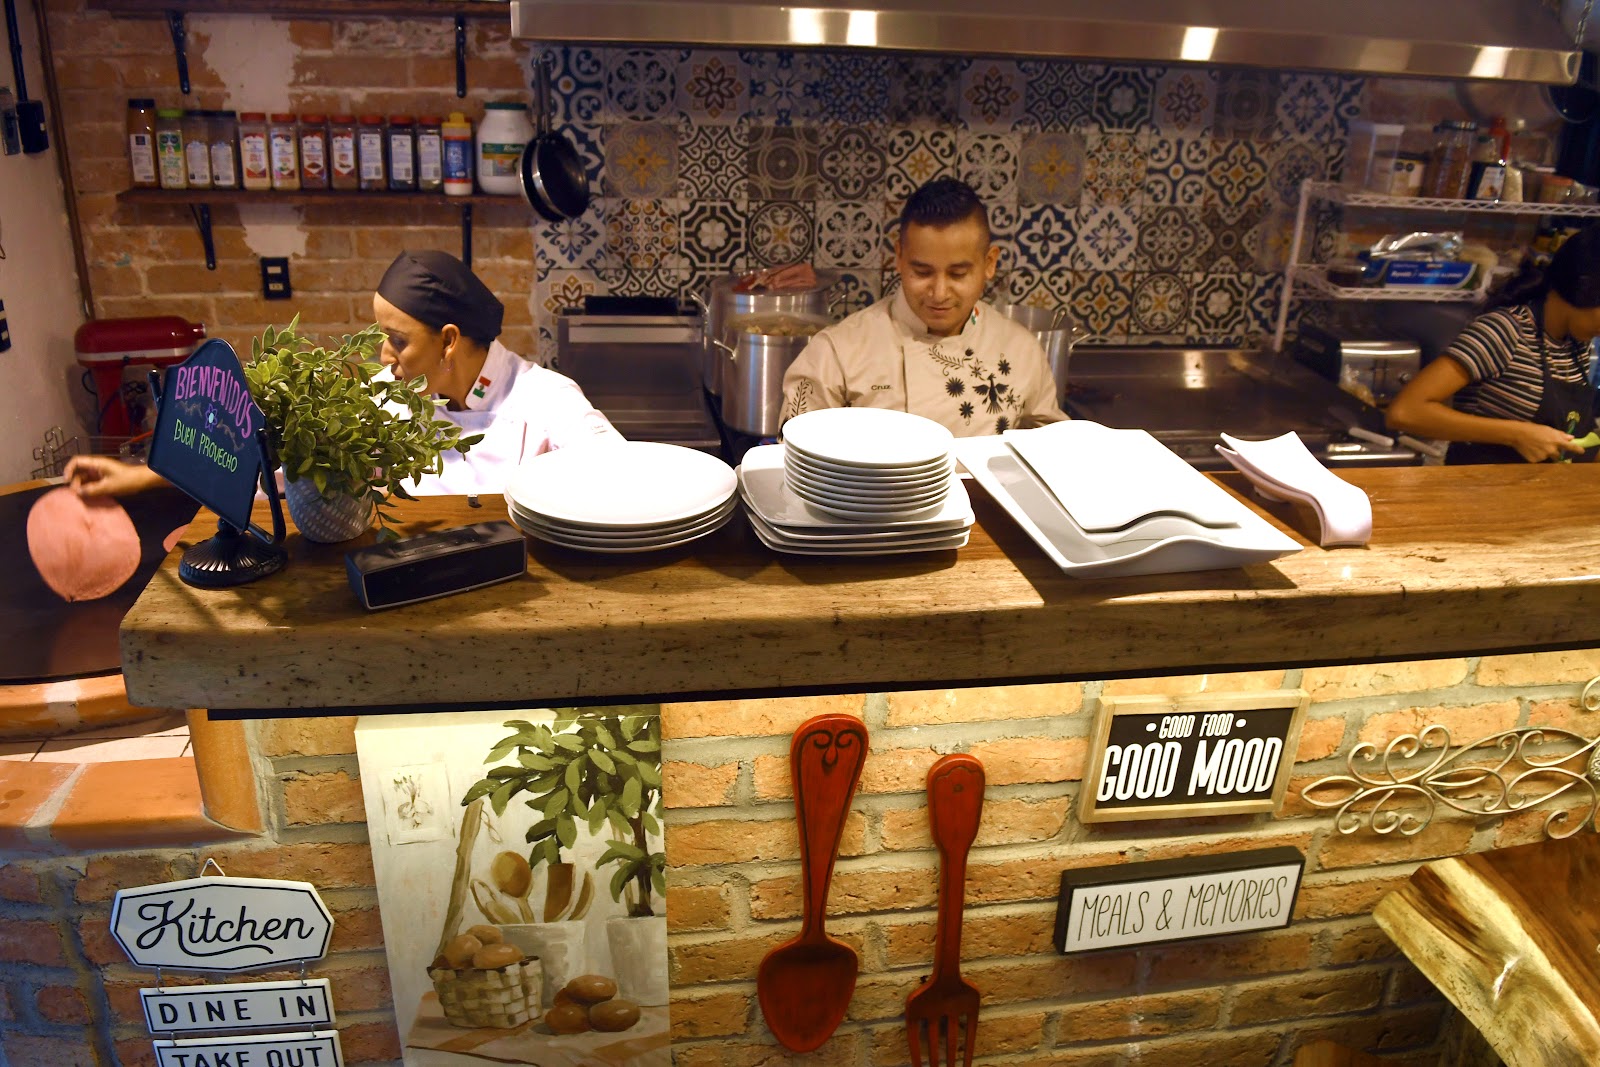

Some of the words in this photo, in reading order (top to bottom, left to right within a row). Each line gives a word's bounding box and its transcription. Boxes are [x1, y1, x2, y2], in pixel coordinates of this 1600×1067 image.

[174, 365, 254, 439] BIENVENIDOS
[173, 418, 197, 449] BUEN
[198, 432, 238, 473] PROVECHO
[1158, 714, 1196, 739] GOOD
[1199, 713, 1234, 738] FOOD
[1096, 741, 1182, 802] GOOD
[1187, 736, 1283, 796] MOOD
[136, 898, 315, 957] Kitchen
[1155, 888, 1173, 931] &
[158, 999, 252, 1024] DINE
[279, 995, 316, 1018] IN
[171, 1051, 250, 1067] TAKE
[266, 1047, 323, 1067] OUT
